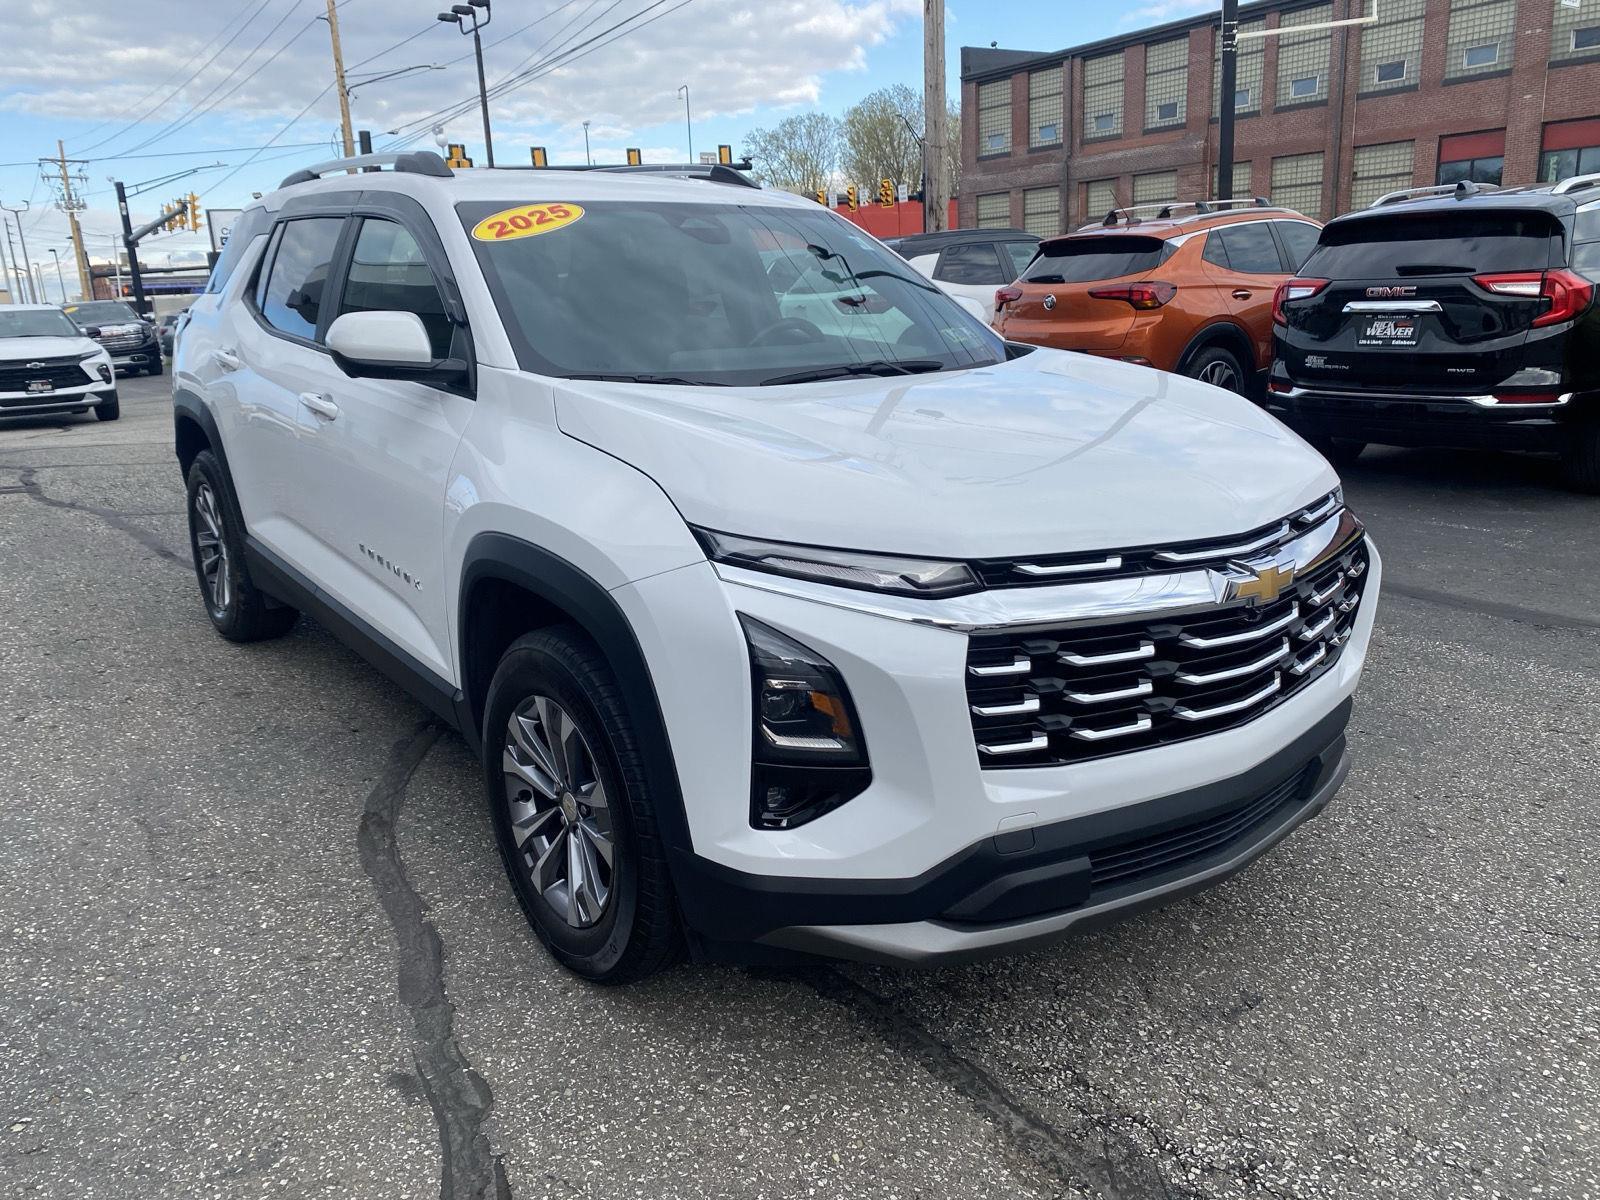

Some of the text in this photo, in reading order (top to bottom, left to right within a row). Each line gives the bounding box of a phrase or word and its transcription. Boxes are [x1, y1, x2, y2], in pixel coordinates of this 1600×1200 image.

[487, 205, 571, 238] 2025
[1366, 286, 1416, 297] GMC
[1372, 321, 1395, 330] RICK
[1366, 327, 1414, 336] WEAVER
